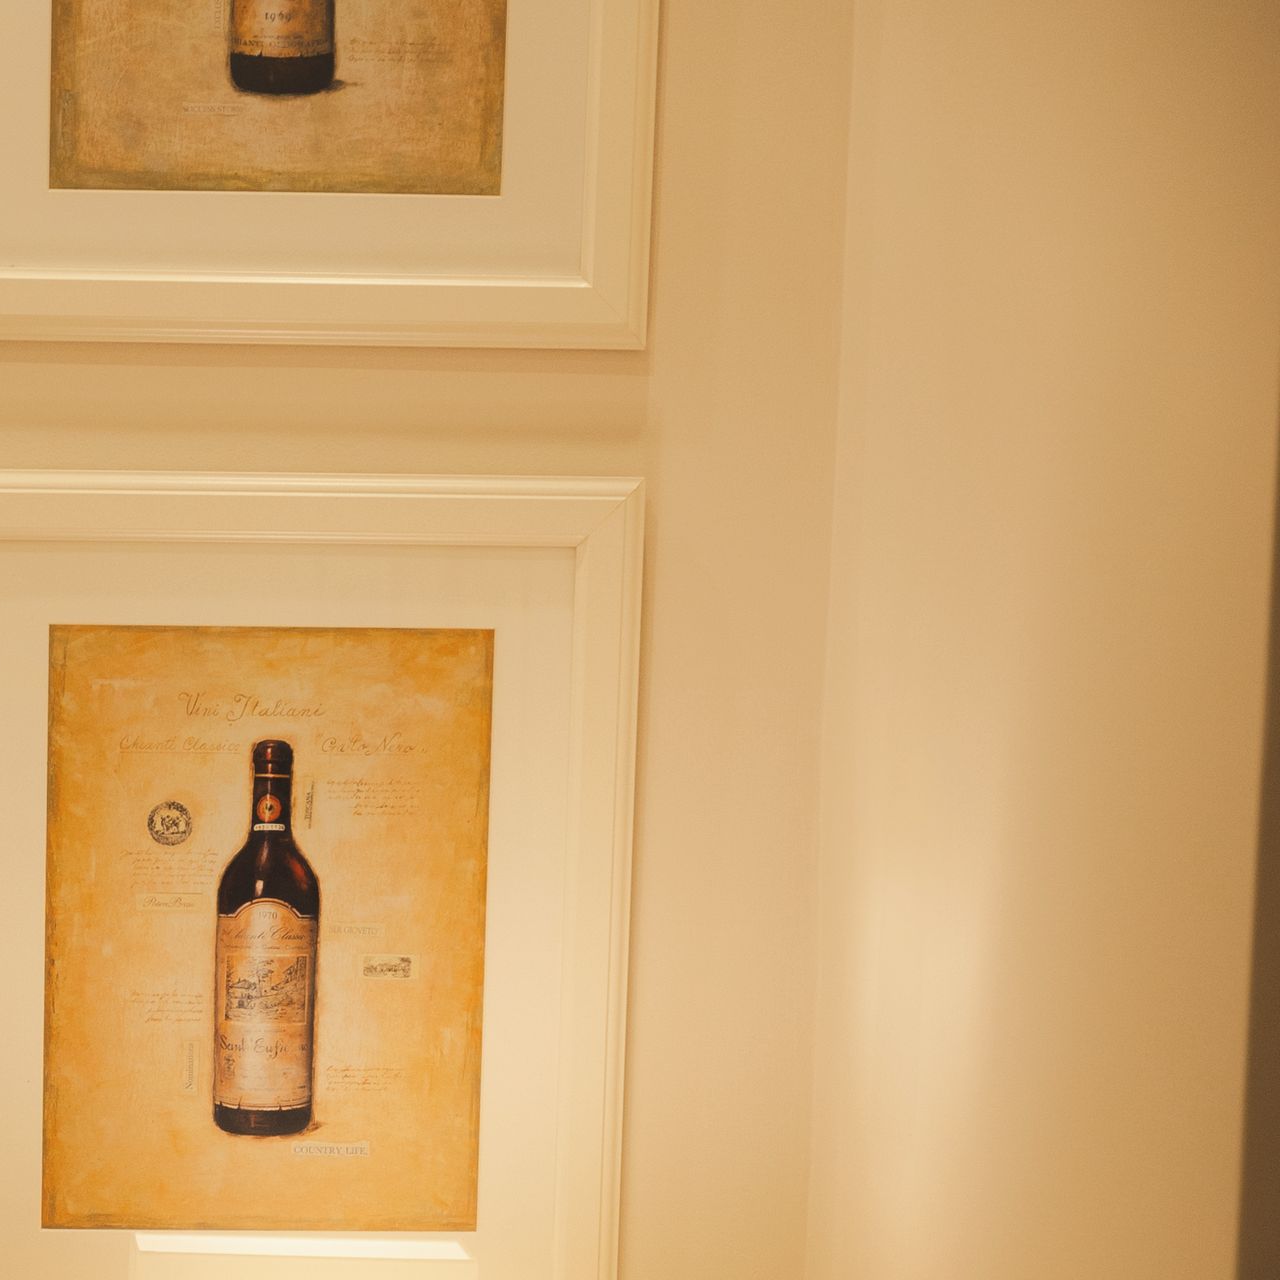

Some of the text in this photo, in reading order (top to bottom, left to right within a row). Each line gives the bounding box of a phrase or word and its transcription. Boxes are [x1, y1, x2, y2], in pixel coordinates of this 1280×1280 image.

[264, 12, 293, 22] 1969
[177, 692, 326, 722] Vini Italiani
[258, 911, 278, 920] 1970
[294, 1145, 343, 1155] COUNTRY
